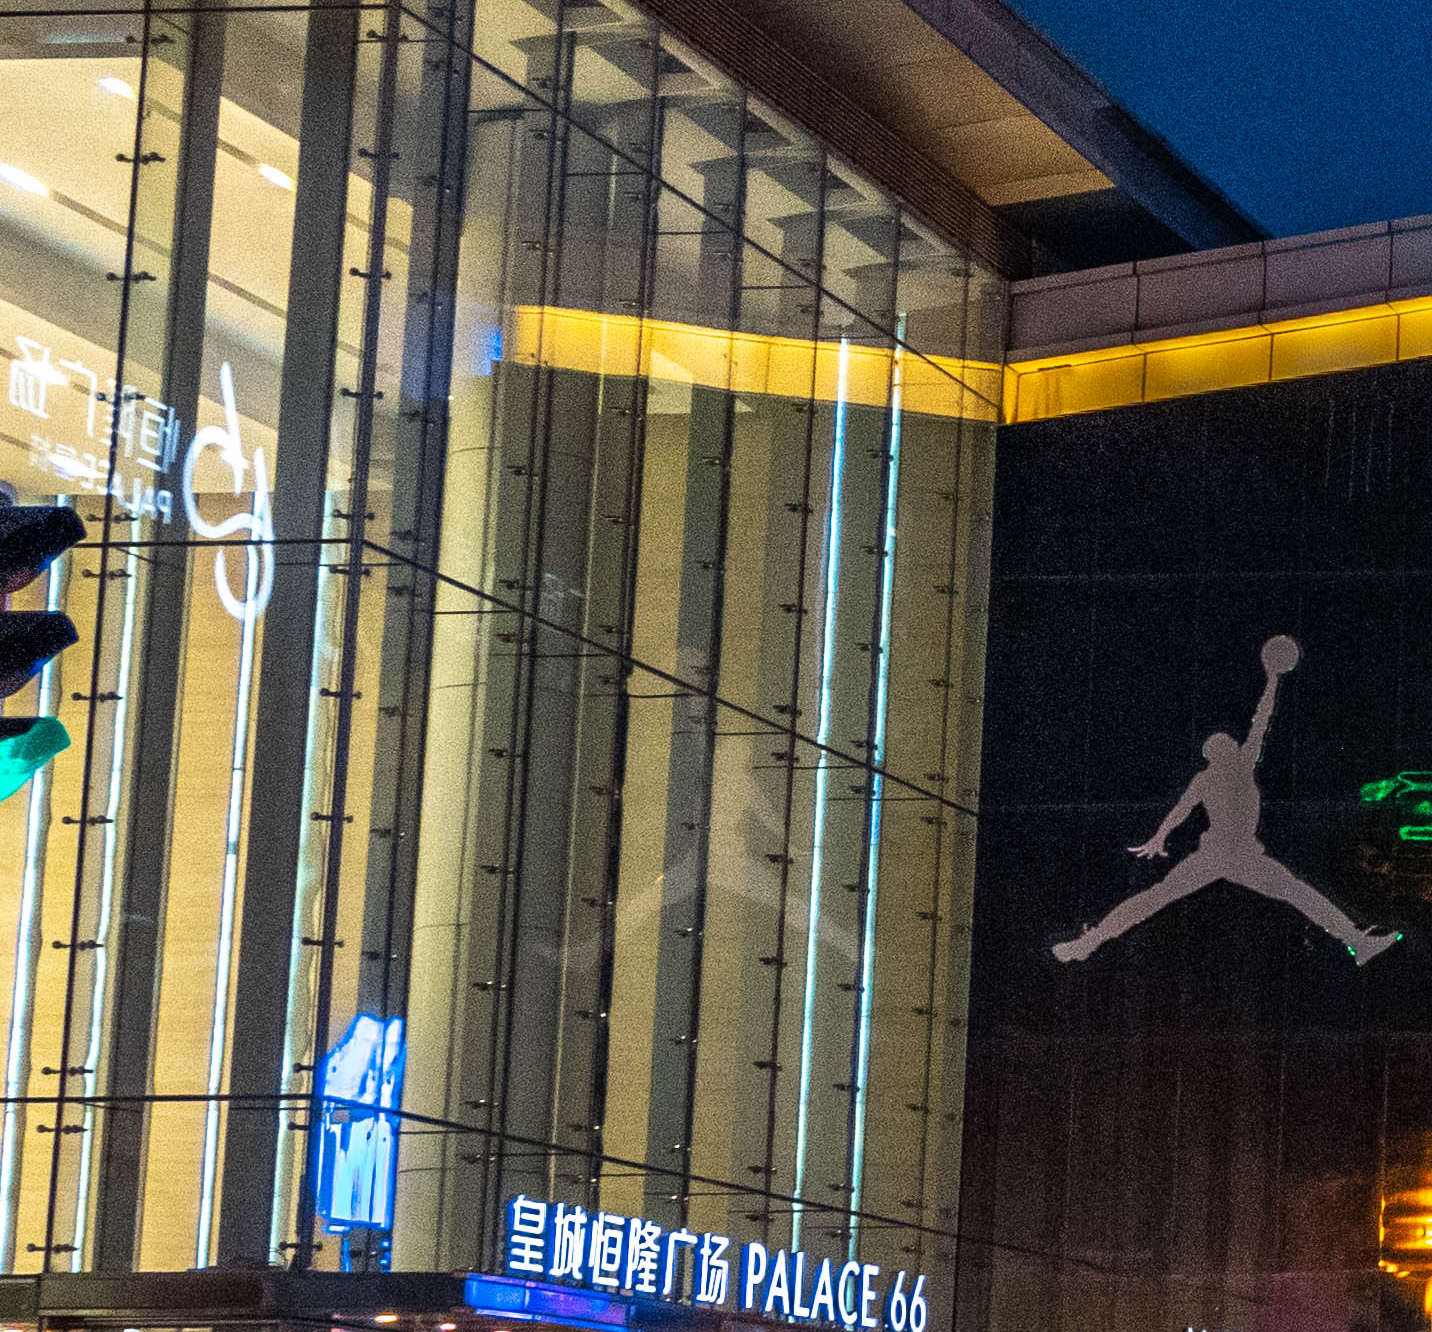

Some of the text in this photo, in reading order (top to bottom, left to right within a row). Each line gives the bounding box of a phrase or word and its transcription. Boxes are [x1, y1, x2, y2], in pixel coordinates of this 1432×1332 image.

[509, 1195, 730, 1305] 皇城恒隆广场
[744, 1241, 880, 1328] PALACE
